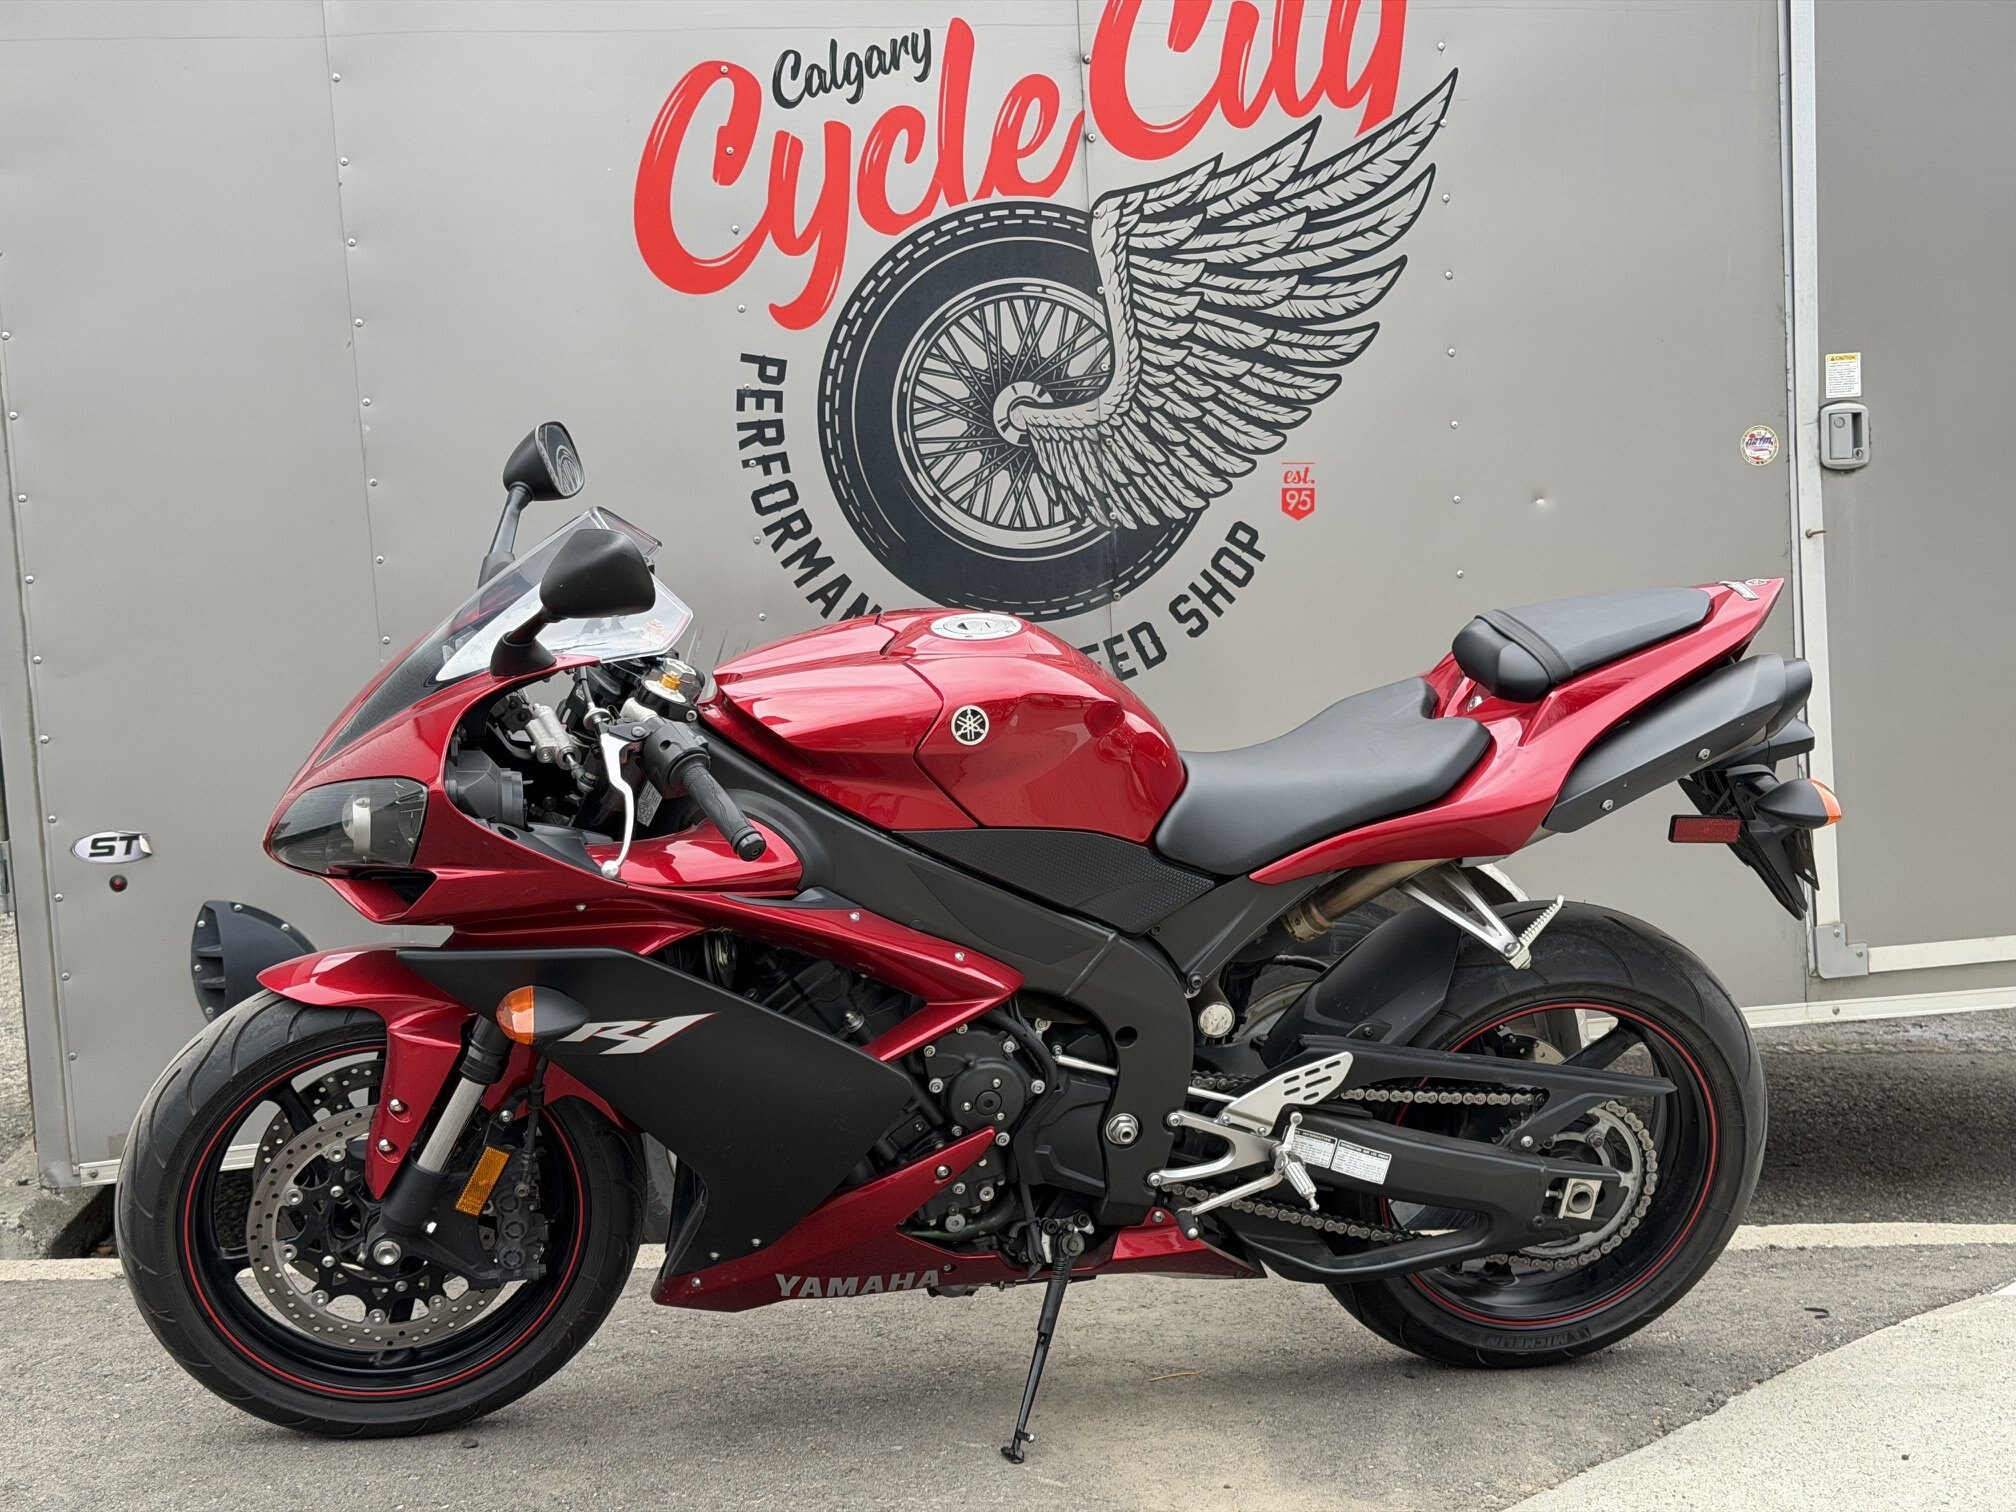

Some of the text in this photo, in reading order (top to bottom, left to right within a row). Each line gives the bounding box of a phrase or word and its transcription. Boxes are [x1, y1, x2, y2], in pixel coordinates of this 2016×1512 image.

[772, 28, 931, 109] Calgary
[633, 0, 1407, 331] Cycle City
[1283, 466, 1315, 484] est.
[1285, 490, 1311, 511] 95
[1168, 520, 1266, 639] SHOP
[88, 835, 140, 858] ST
[556, 1011, 721, 1055] R1
[774, 1269, 939, 1298] YAMAHA
[1486, 1332, 1568, 1349] MICHELIN
